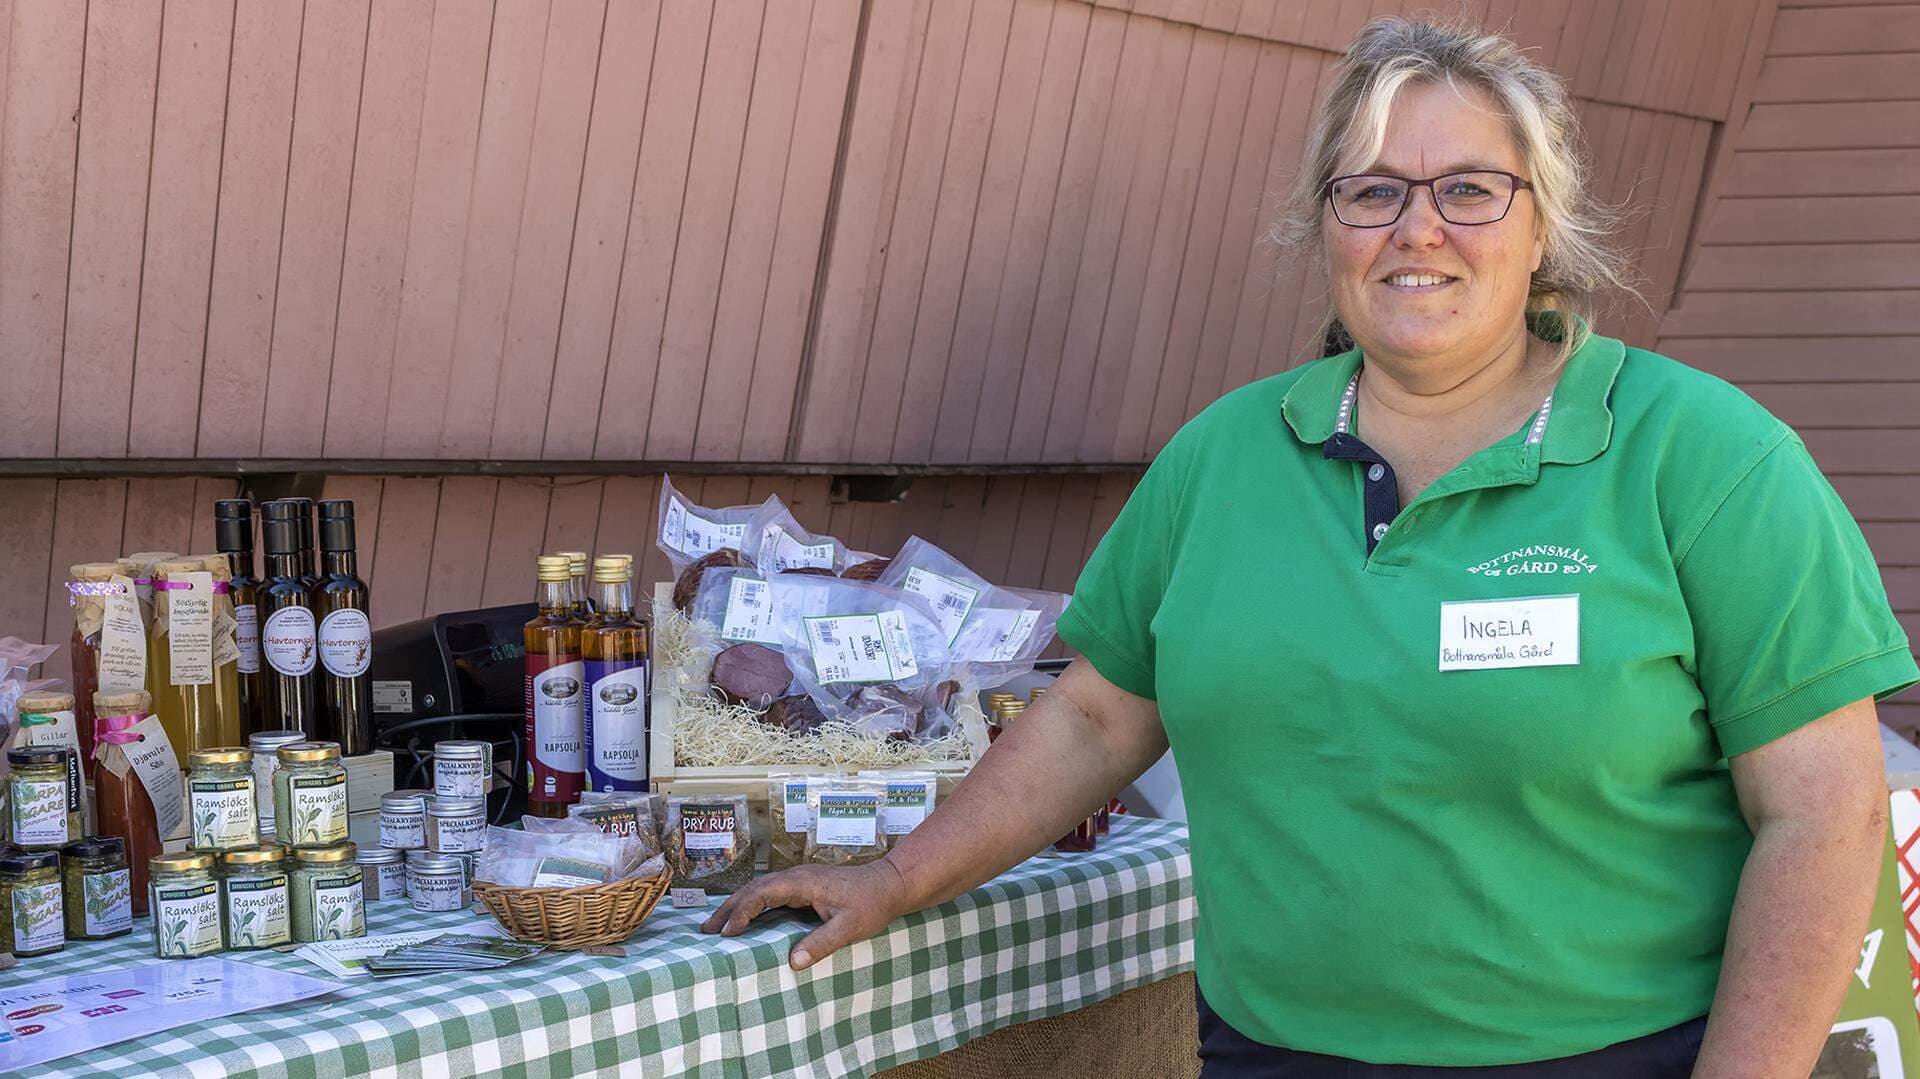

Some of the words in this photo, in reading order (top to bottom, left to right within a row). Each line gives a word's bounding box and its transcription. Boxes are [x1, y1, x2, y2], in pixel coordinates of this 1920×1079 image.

[1467, 544, 1598, 574] BOTTNANSMÅLA
[1506, 561, 1558, 576] GÅRD
[1463, 615, 1533, 640] INGELA
[1442, 645, 1516, 663] Bottnansmåla
[1518, 641, 1555, 659] Gård
[545, 741, 581, 754] RAPSOLJA
[603, 749, 640, 761] RAPSOLJA
[196, 796, 249, 810] Ramslöks
[856, 806, 870, 815] fisk
[227, 807, 249, 819] salt
[611, 821, 637, 836] RUB
[683, 816, 706, 831] DRY
[710, 816, 736, 831] RUB
[233, 892, 285, 909] Ramslöks
[165, 900, 217, 917] Ramslöks
[266, 903, 286, 918] salt
[198, 910, 218, 925] salt
